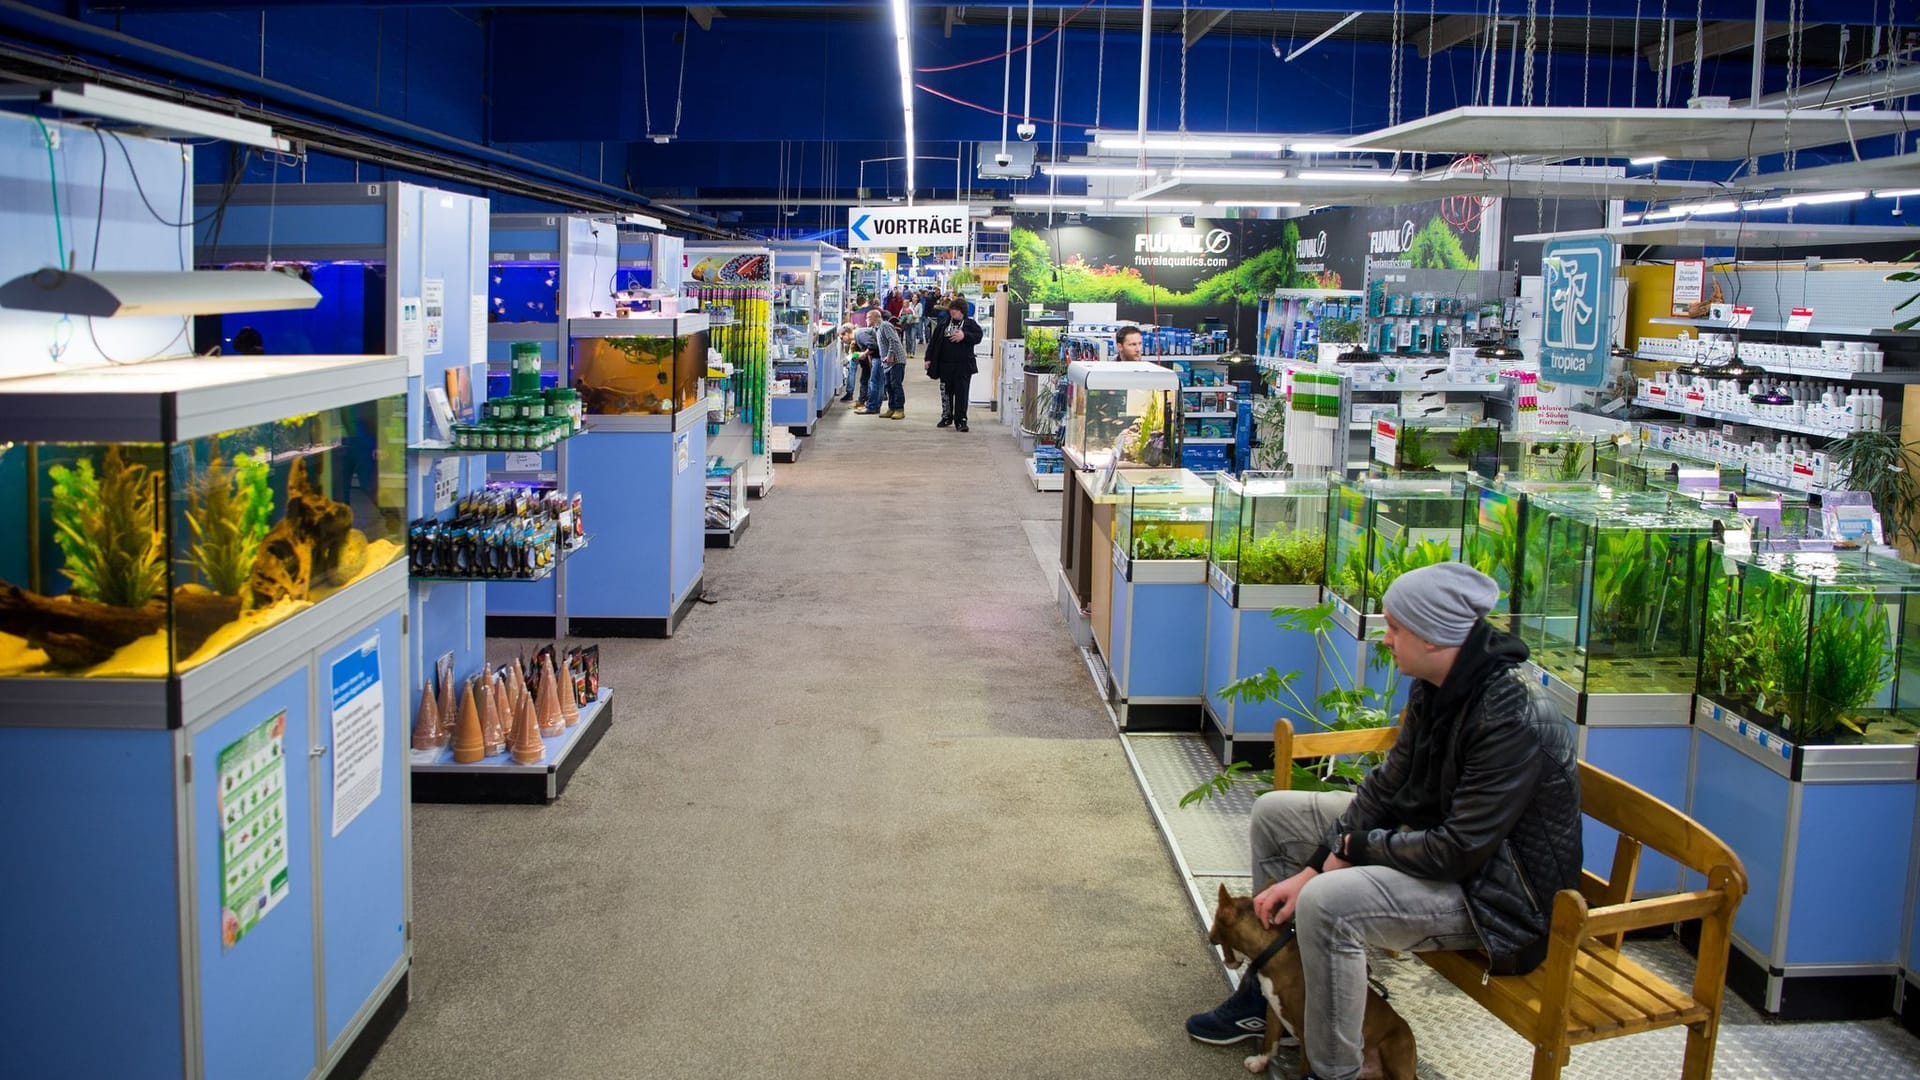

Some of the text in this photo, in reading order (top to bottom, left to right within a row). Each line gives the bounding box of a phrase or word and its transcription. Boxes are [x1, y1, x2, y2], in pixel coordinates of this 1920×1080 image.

[873, 215, 963, 235] VORTRÄGE
[1134, 233, 1204, 253] FLUVAL
[1296, 238, 1318, 259] FLUVAL
[1370, 229, 1401, 254] FLUVAL
[1134, 255, 1228, 268] fluvalaquatics.com
[1551, 352, 1586, 374] tropica
